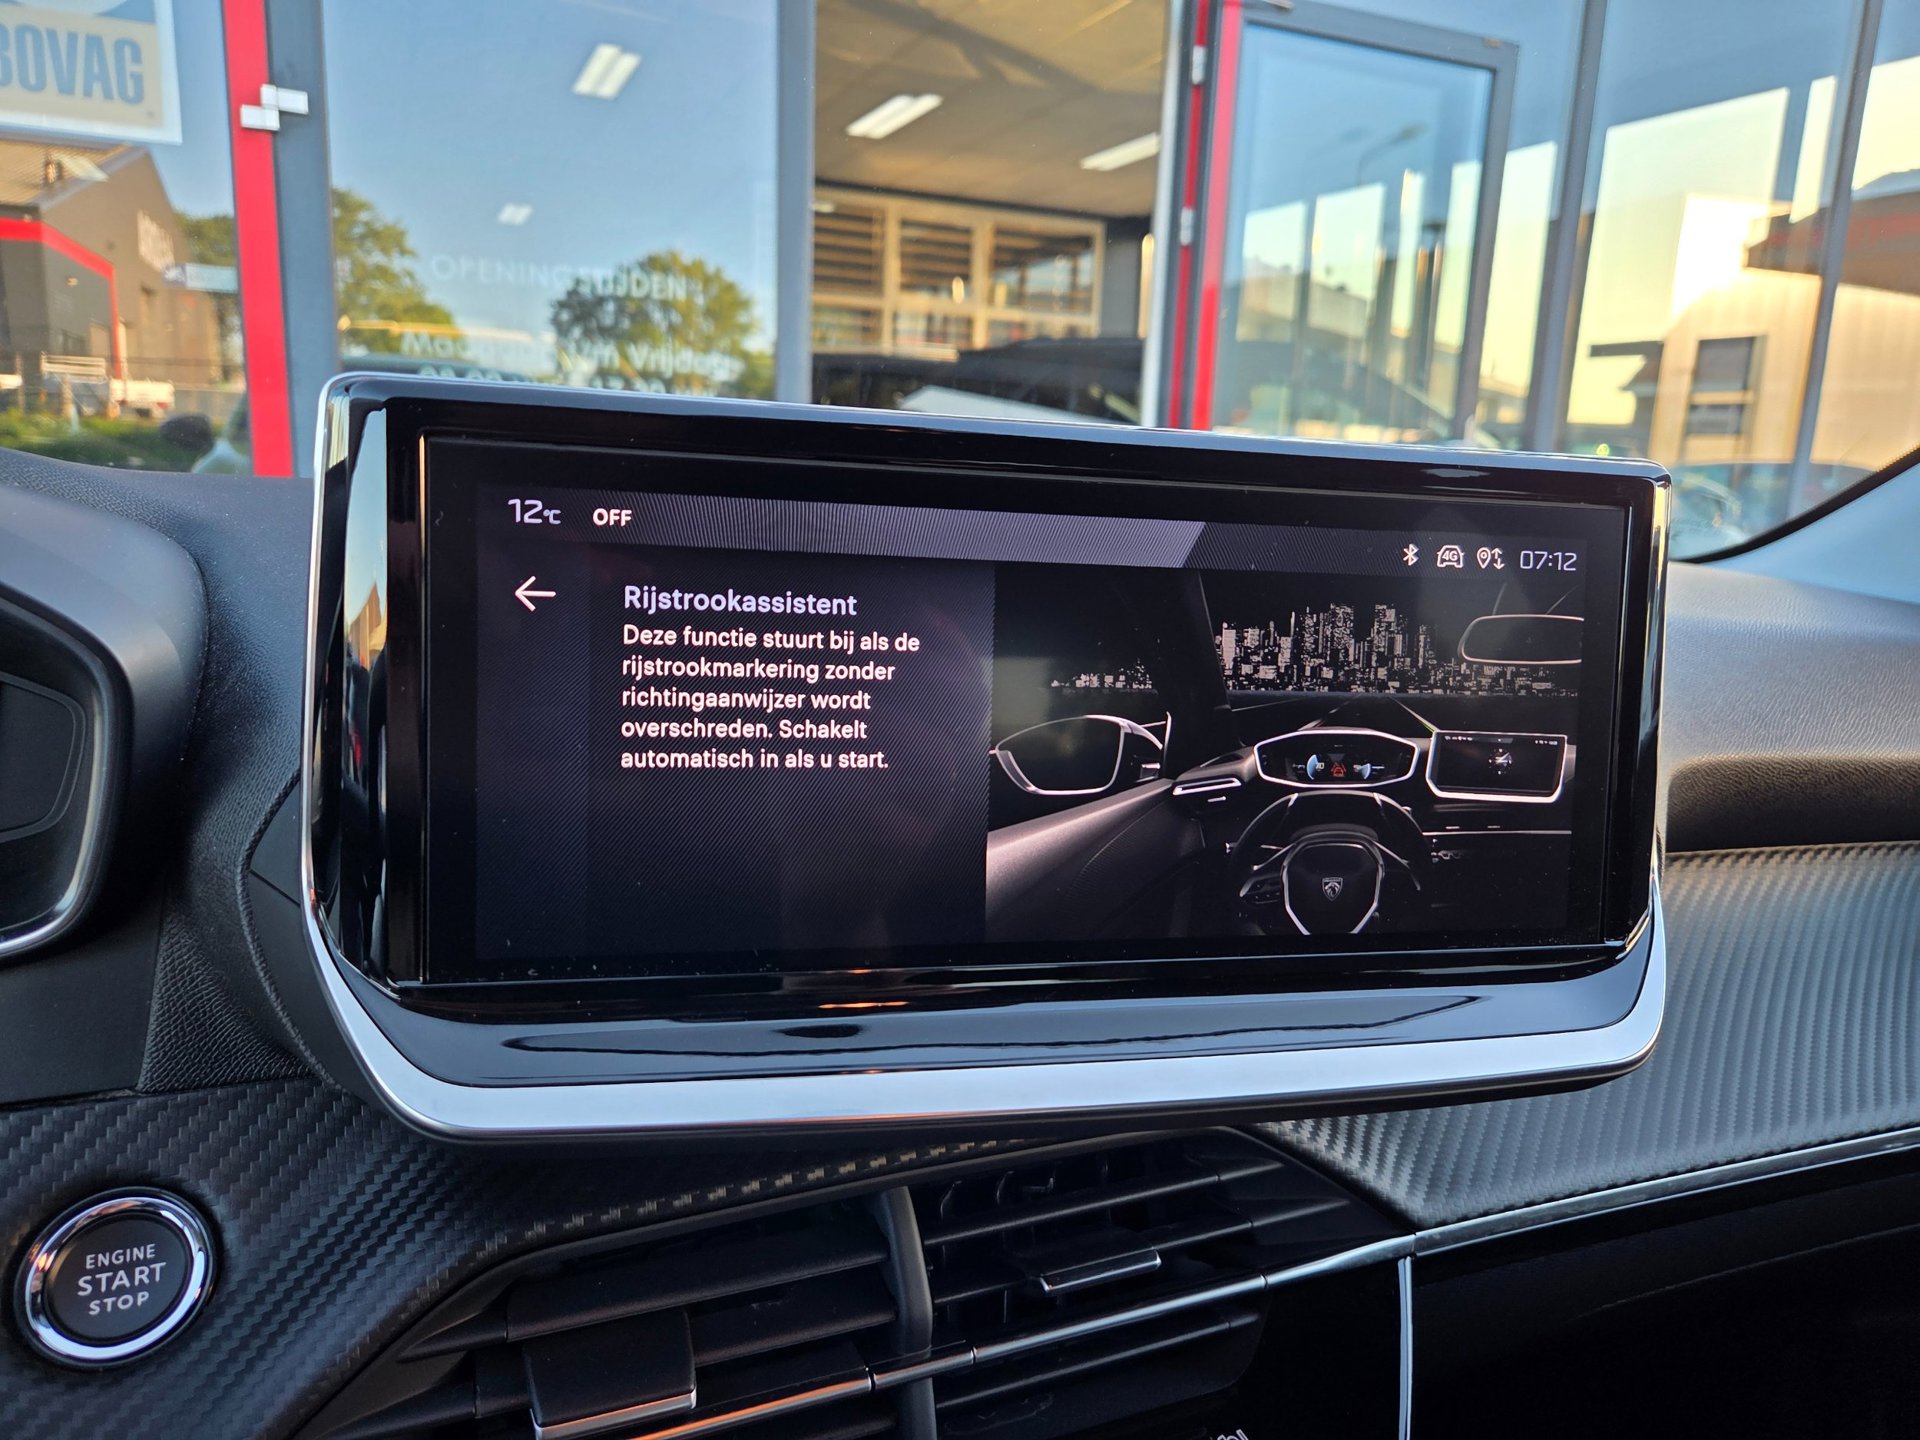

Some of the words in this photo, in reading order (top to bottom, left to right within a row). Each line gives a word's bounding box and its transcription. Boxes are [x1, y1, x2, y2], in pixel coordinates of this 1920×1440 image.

[592, 507, 633, 527] OFF
[1519, 550, 1578, 571] 07:12
[624, 585, 858, 616] Rijstrookassistent
[623, 624, 678, 647] Deze
[683, 625, 758, 648] functie
[762, 630, 825, 650] stuurt
[829, 629, 855, 655] bij
[859, 631, 890, 651] als
[894, 632, 921, 652] de
[622, 655, 820, 685] rijstrookmarkering
[824, 660, 896, 681] zonder
[622, 686, 806, 714] richtingaanwijzer
[810, 690, 872, 710] wordt
[621, 717, 773, 739] overschreden.
[778, 718, 868, 740] Schakelt
[620, 747, 754, 769] automatisch
[760, 747, 779, 769] in
[784, 748, 815, 769] als
[820, 753, 833, 769] u
[838, 750, 889, 770] start.
[85, 1243, 156, 1270] ENGINE
[77, 1261, 167, 1296] START
[88, 1291, 150, 1316] STOP
